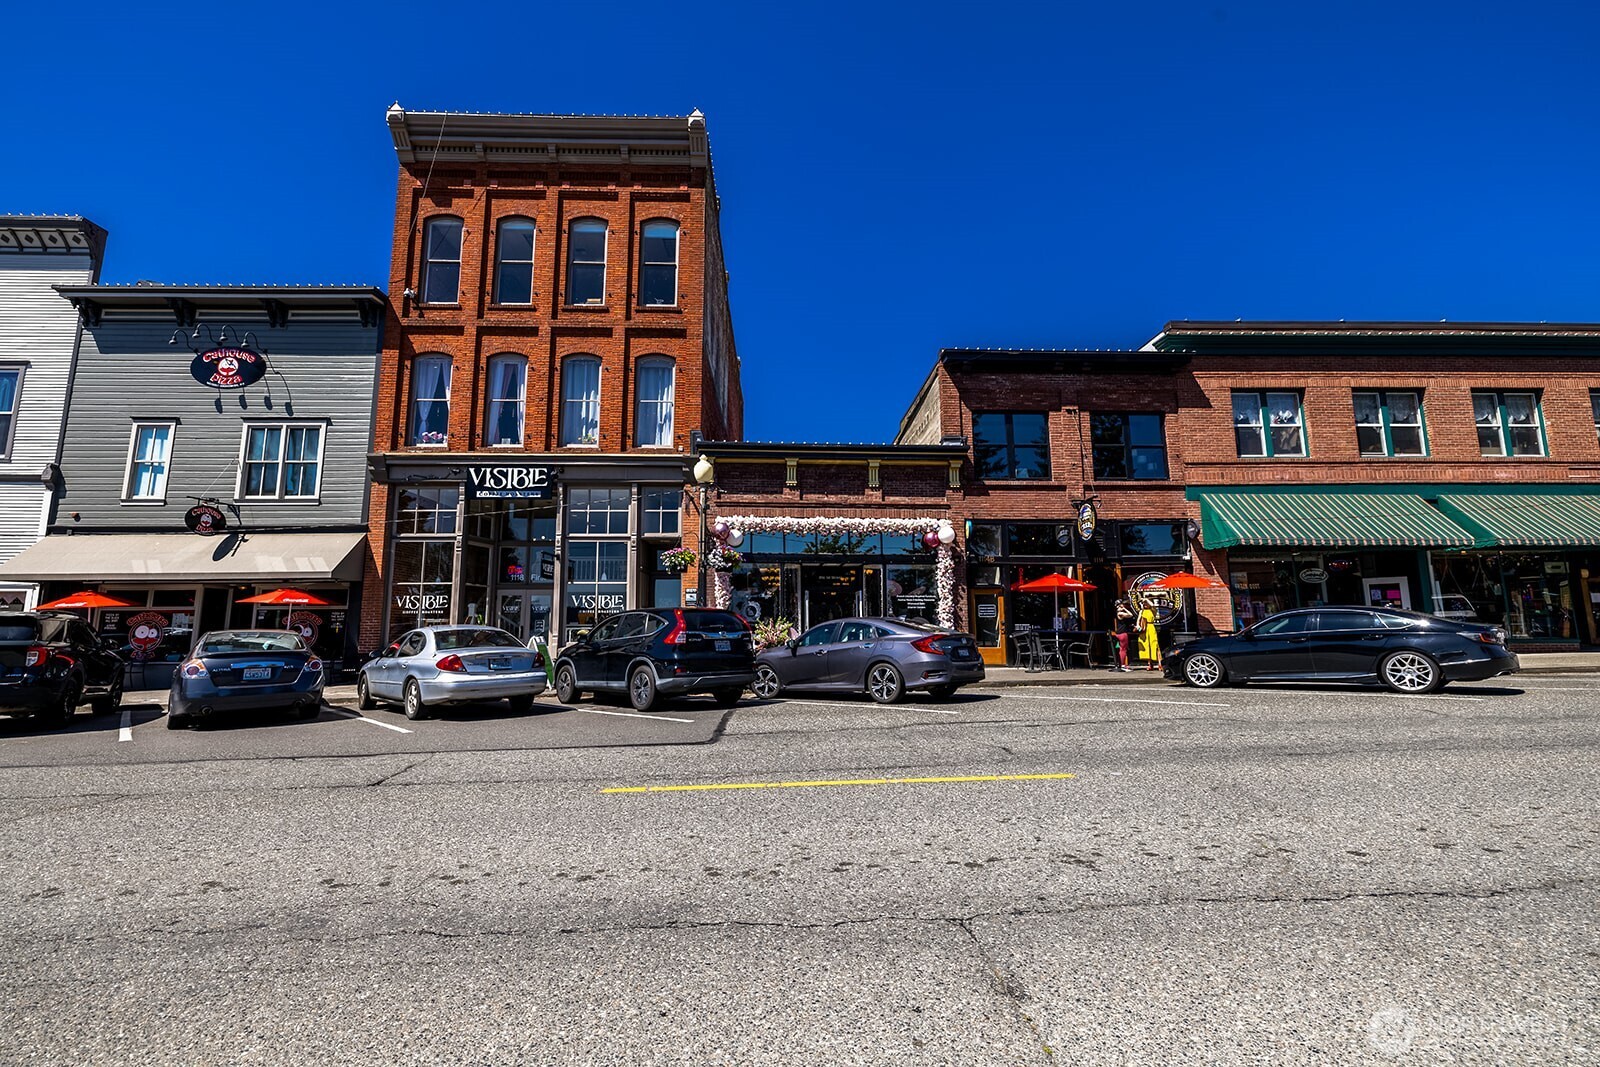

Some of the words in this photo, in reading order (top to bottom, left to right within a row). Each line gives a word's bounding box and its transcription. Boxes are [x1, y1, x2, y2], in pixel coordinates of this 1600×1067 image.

[468, 467, 548, 489] VISIBLE
[395, 595, 449, 610] VISIBLE
[571, 595, 624, 610] VISIBLE
